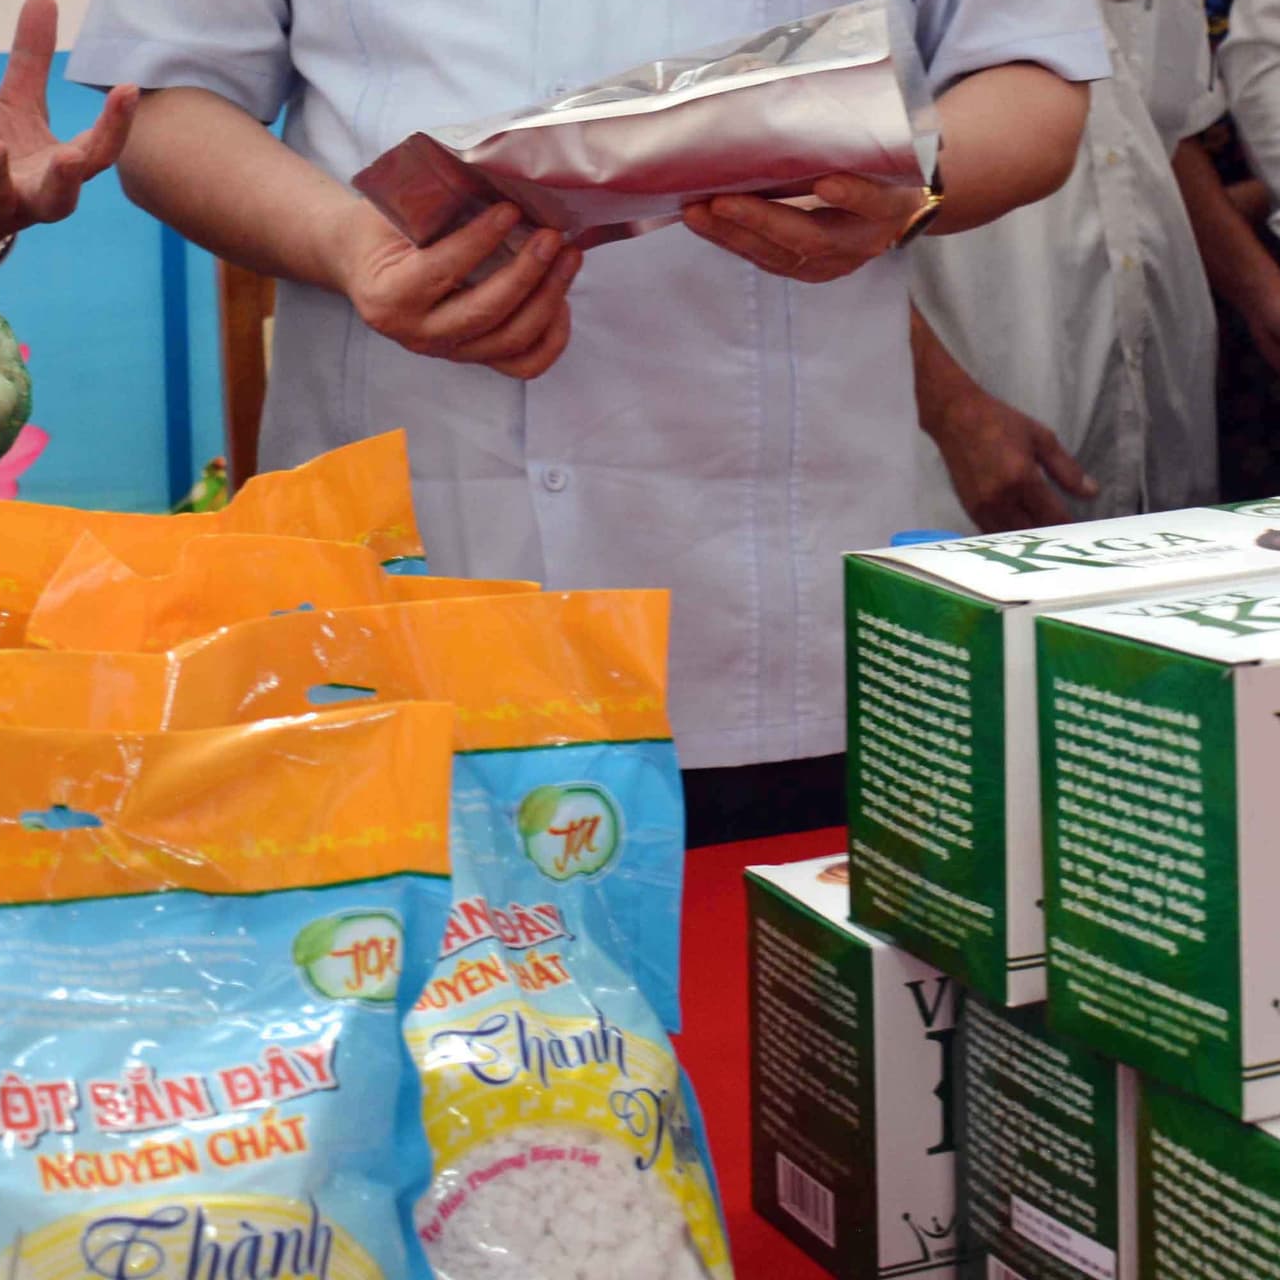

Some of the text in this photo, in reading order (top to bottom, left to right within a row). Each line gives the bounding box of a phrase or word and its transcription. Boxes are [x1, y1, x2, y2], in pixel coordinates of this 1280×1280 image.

[958, 531, 1218, 575] KIGA
[415, 950, 571, 1012] UYÊN HẤT
[89, 1065, 209, 1130] SẮN
[219, 1043, 336, 1109] DÂY
[429, 1004, 630, 1089] Thành
[36, 1106, 309, 1192] NGUYÊN CHẤT
